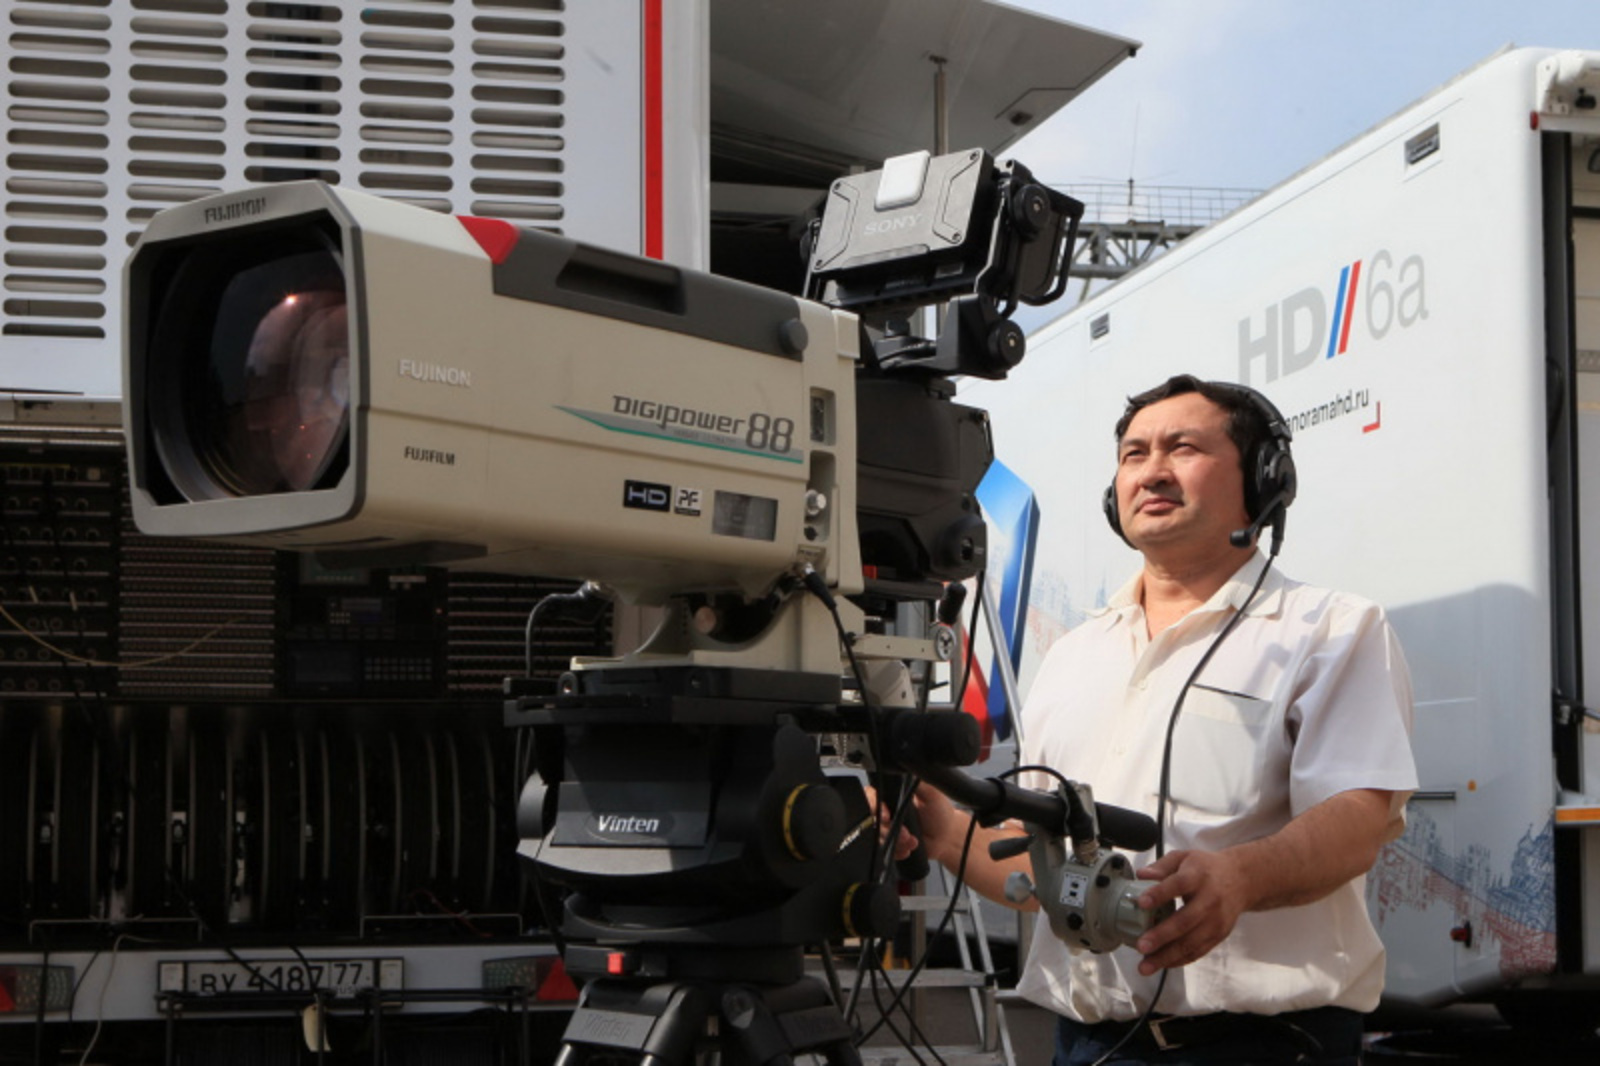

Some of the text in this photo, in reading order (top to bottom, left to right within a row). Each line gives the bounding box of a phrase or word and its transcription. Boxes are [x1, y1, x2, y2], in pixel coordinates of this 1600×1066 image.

[204, 197, 267, 224] FUJINON
[863, 213, 923, 236] SONY
[399, 359, 471, 388] FUJINON
[1285, 388, 1369, 433] anoramahd.ru
[404, 446, 456, 466] FUJIFILM
[628, 486, 668, 506] HD
[598, 814, 660, 833] Vinten
[334, 963, 364, 985] 77
